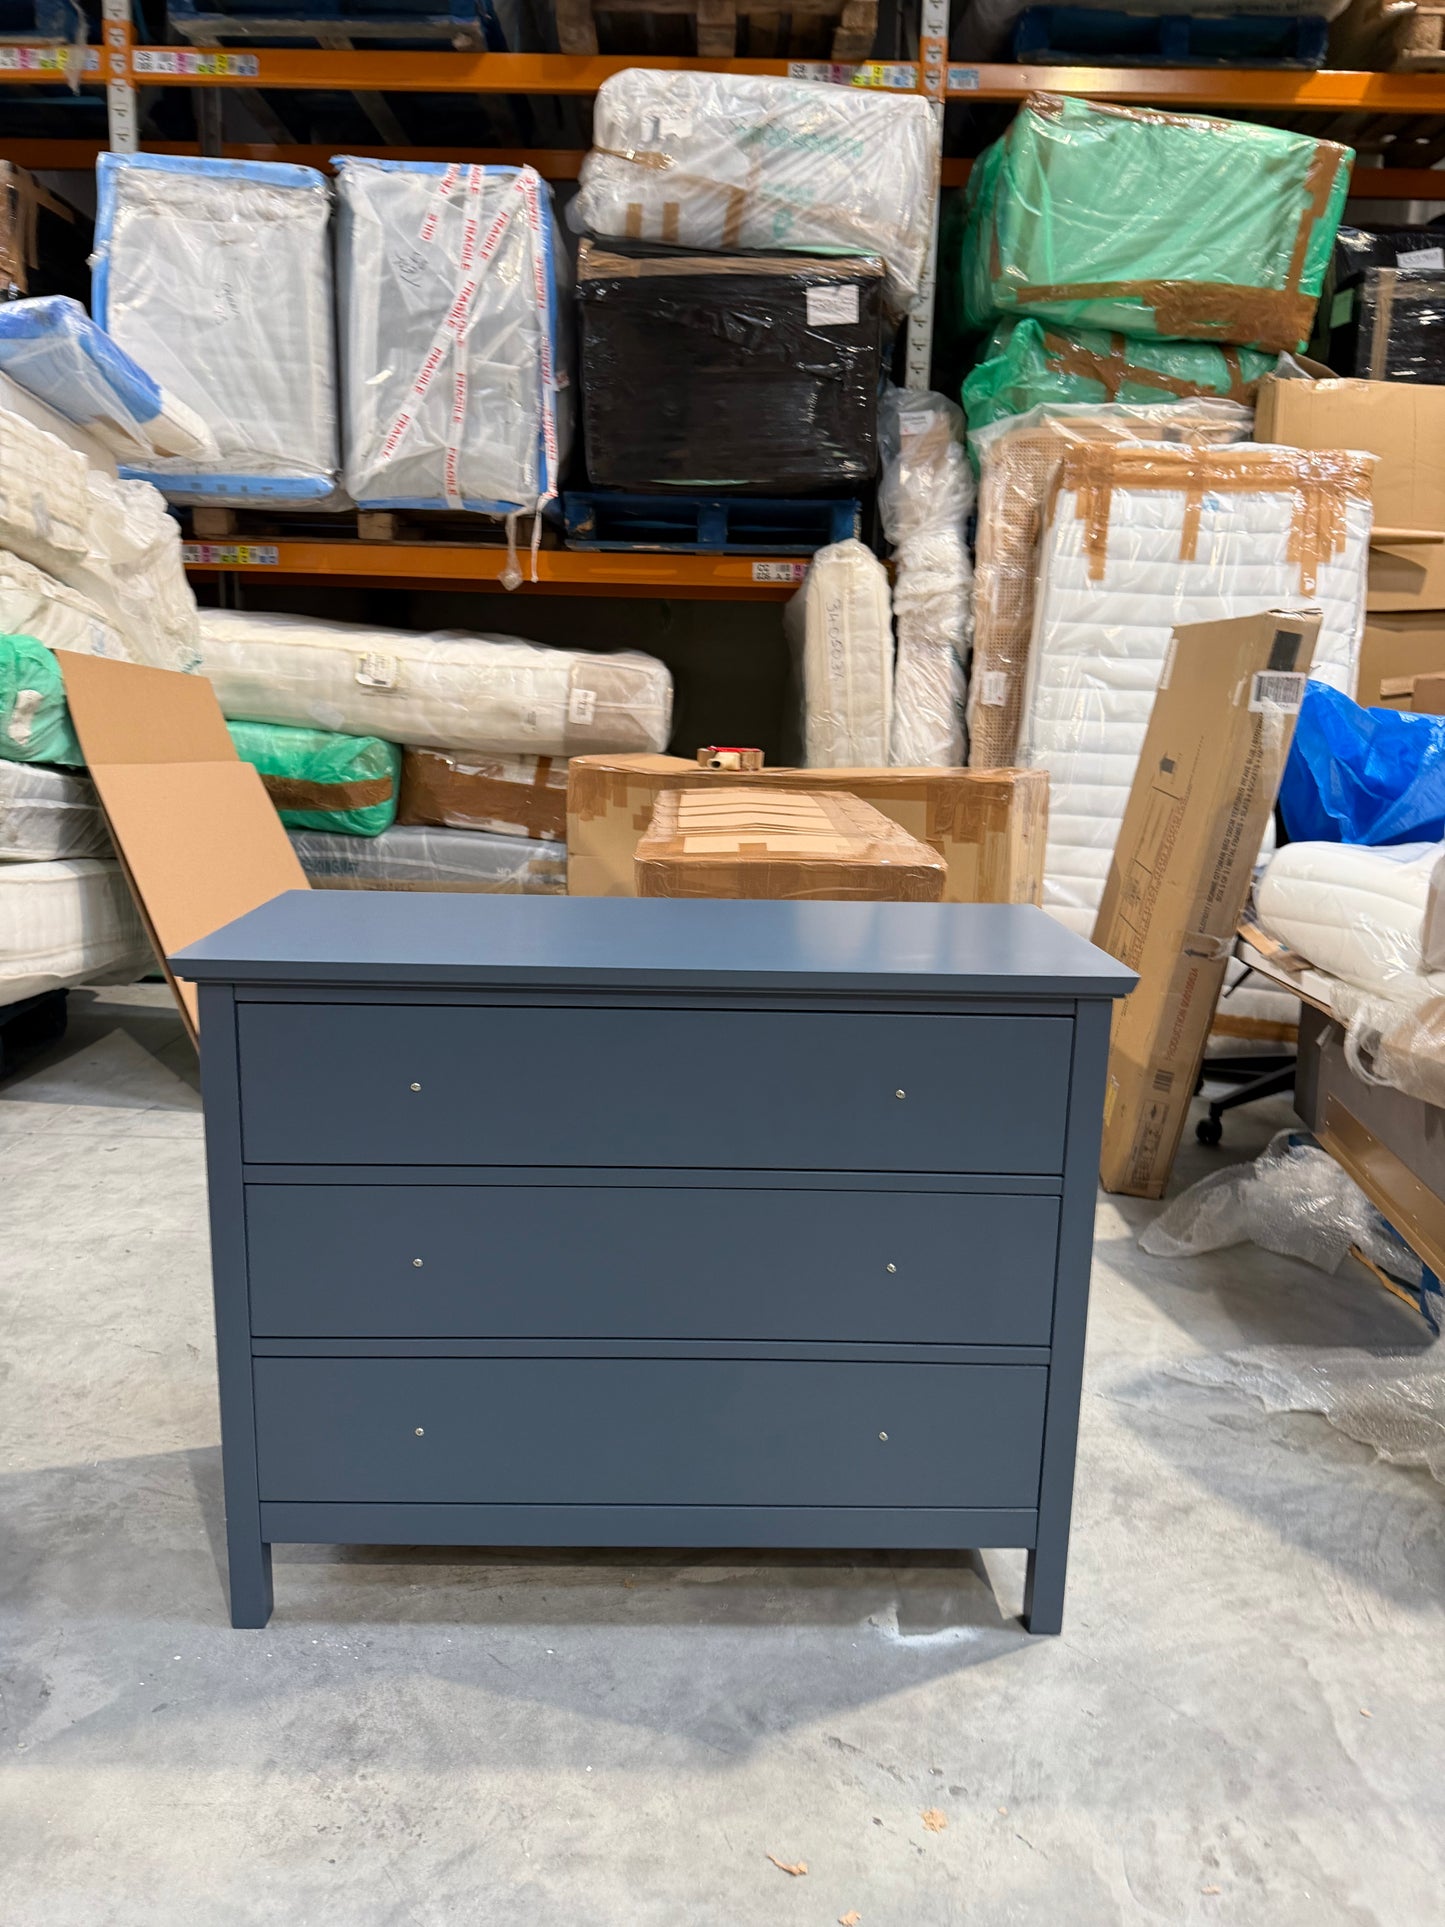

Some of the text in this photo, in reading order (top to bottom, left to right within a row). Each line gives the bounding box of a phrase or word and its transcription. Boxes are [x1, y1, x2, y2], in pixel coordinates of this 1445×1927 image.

[461, 219, 477, 270] FRAGILE
[480, 211, 509, 259] FRAGILE
[446, 280, 476, 329] FRAGILE
[412, 346, 444, 396] FRAGILE
[454, 372, 467, 424] FRAGILE
[383, 413, 411, 459] FRAGILE
[446, 447, 459, 497] FRAGILE
